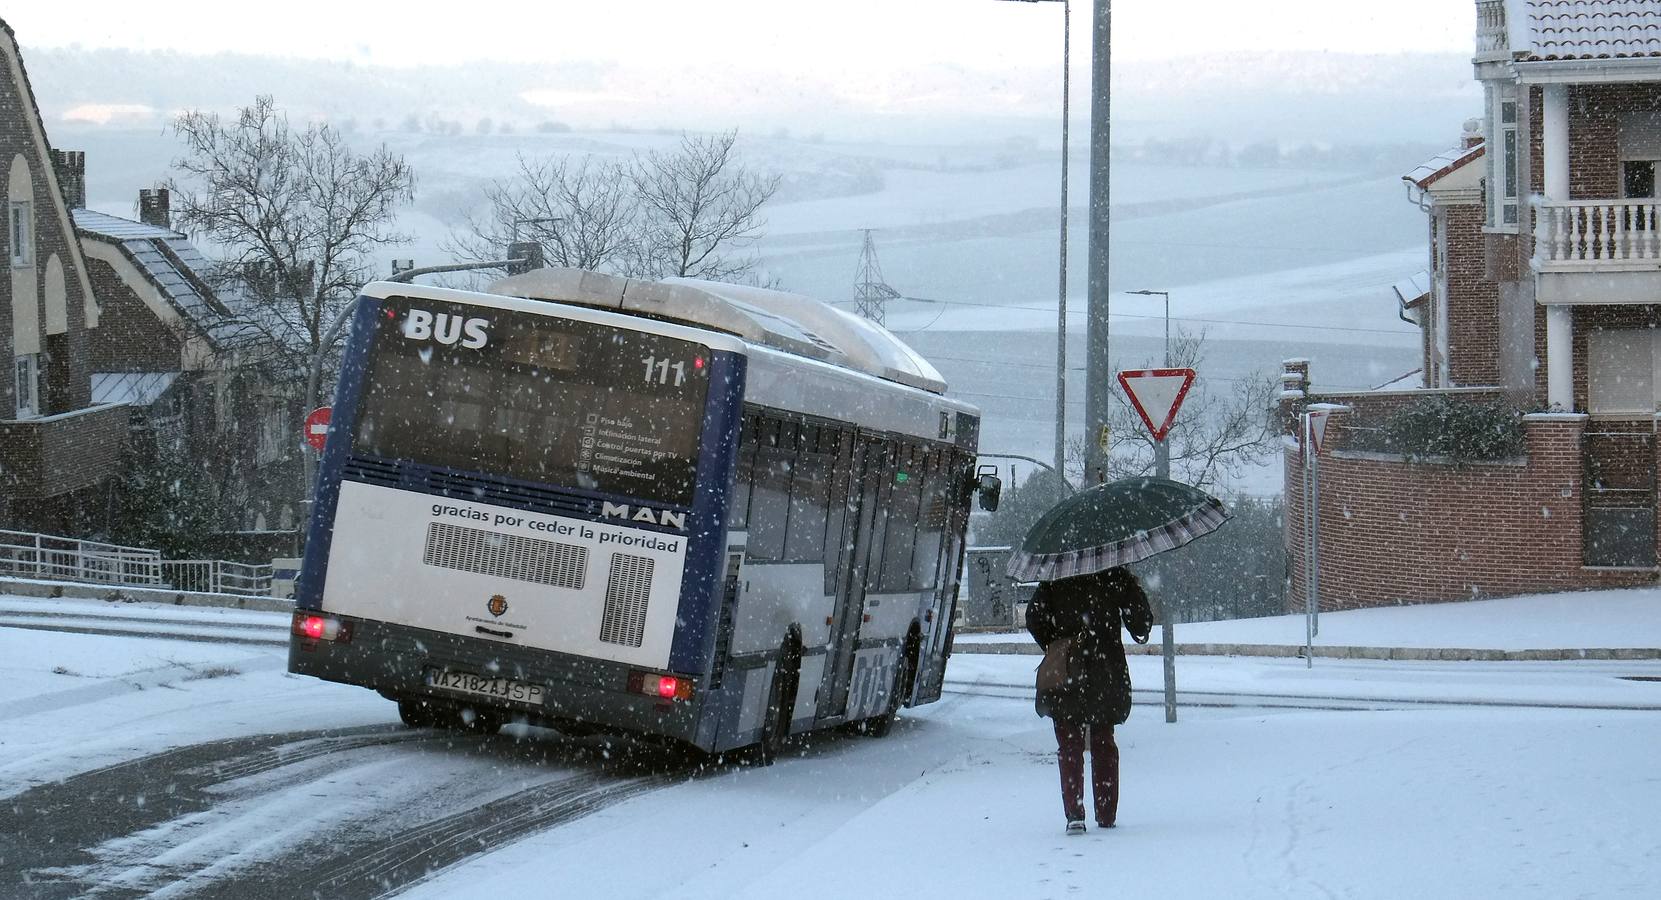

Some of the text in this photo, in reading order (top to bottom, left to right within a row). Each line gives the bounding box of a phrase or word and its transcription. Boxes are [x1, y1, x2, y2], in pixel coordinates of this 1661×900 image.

[404, 308, 489, 349] BUS
[640, 356, 686, 387] 111
[597, 440, 678, 459] Control puertas por TV
[638, 435, 661, 444] lateral
[619, 470, 656, 480] ambiental
[431, 503, 678, 552] gracias por ceder la prioridad
[601, 501, 686, 528] MAN
